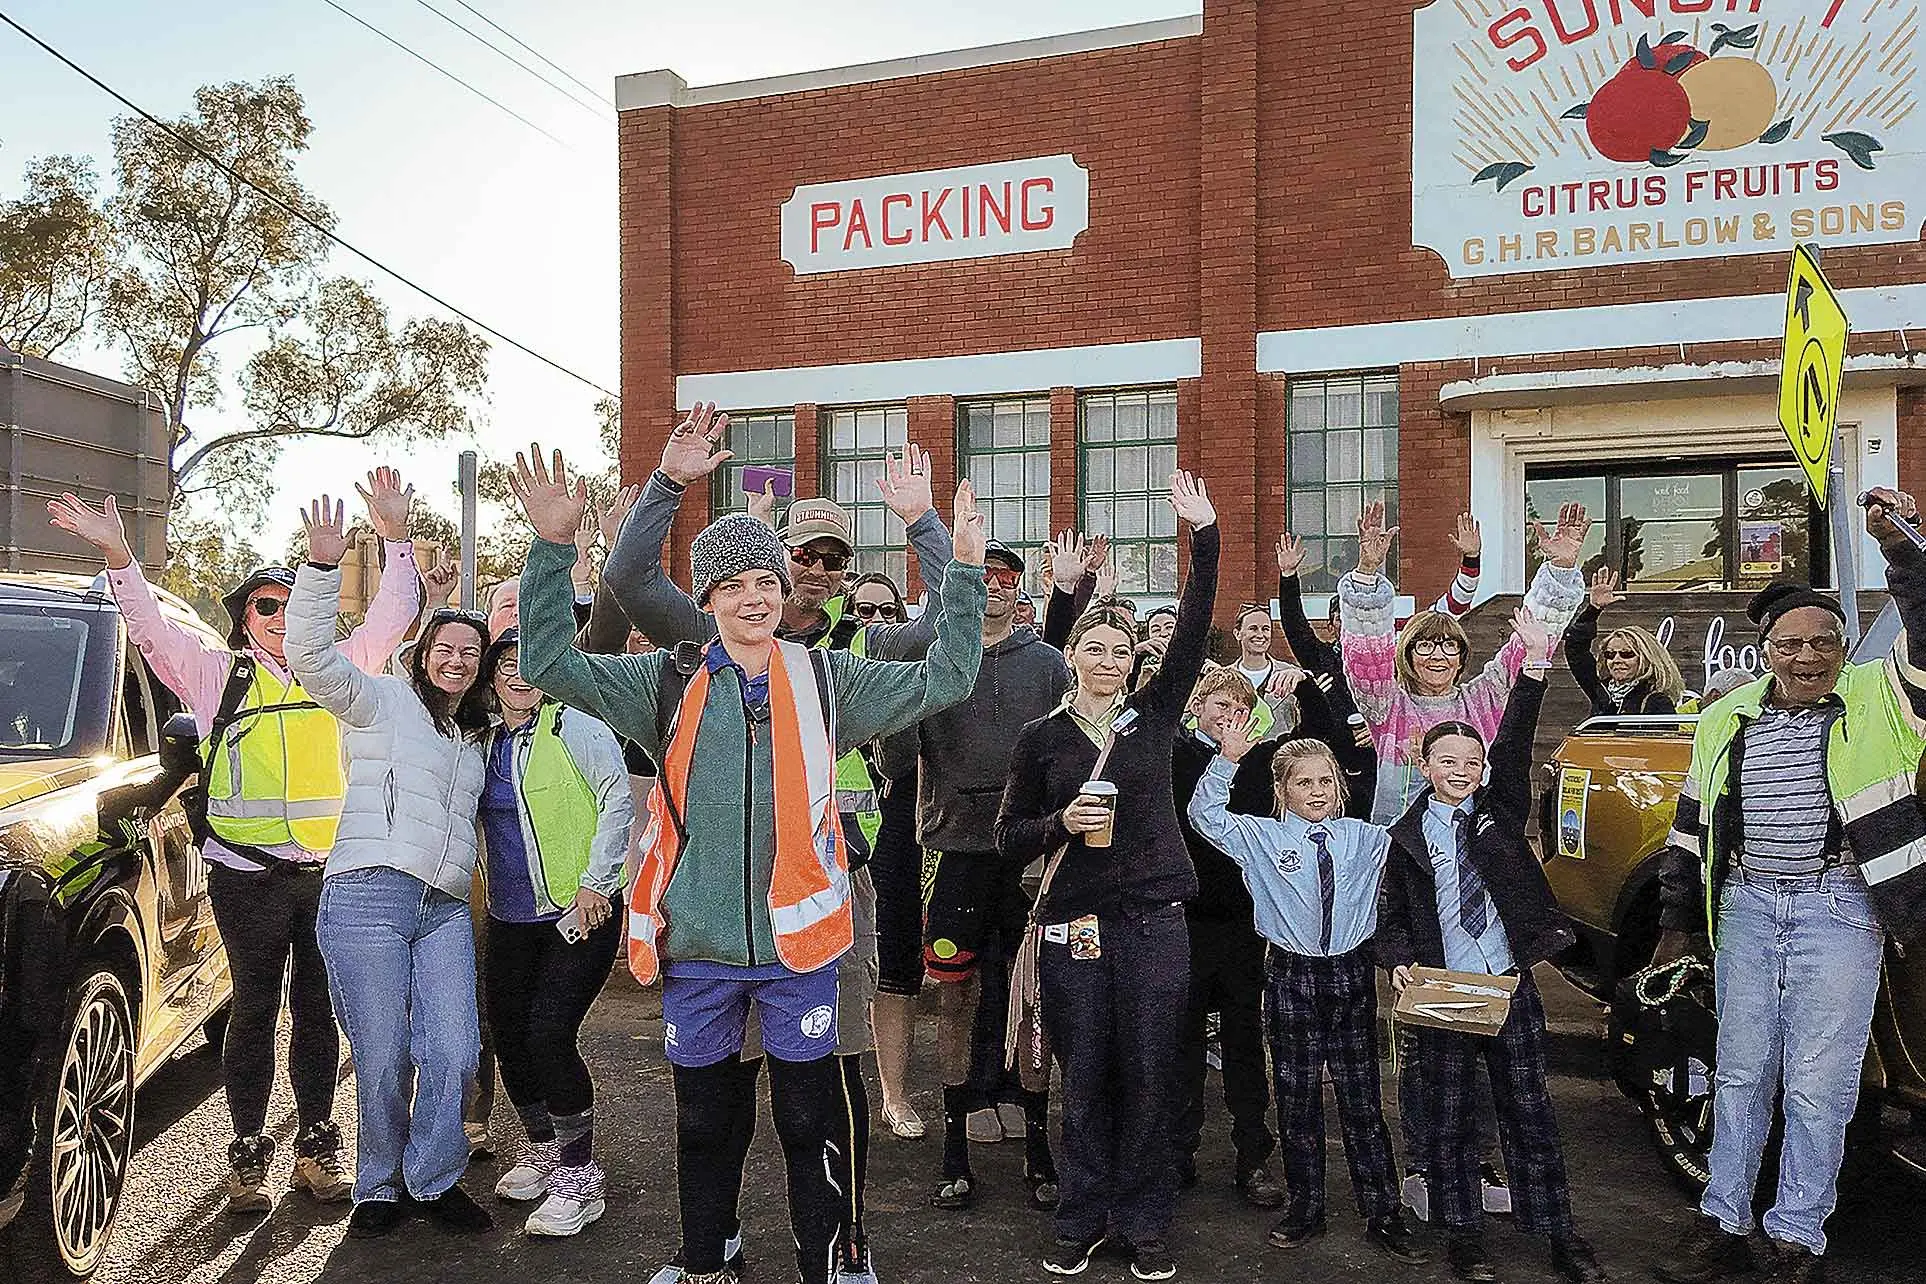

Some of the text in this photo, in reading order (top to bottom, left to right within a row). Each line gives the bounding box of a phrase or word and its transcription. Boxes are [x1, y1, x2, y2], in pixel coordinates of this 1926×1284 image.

[810, 177, 1054, 253] PACKING
[1522, 159, 1840, 218] CITRUS FRUITS
[1752, 211, 1776, 241] &
[1790, 200, 1906, 238] SONS
